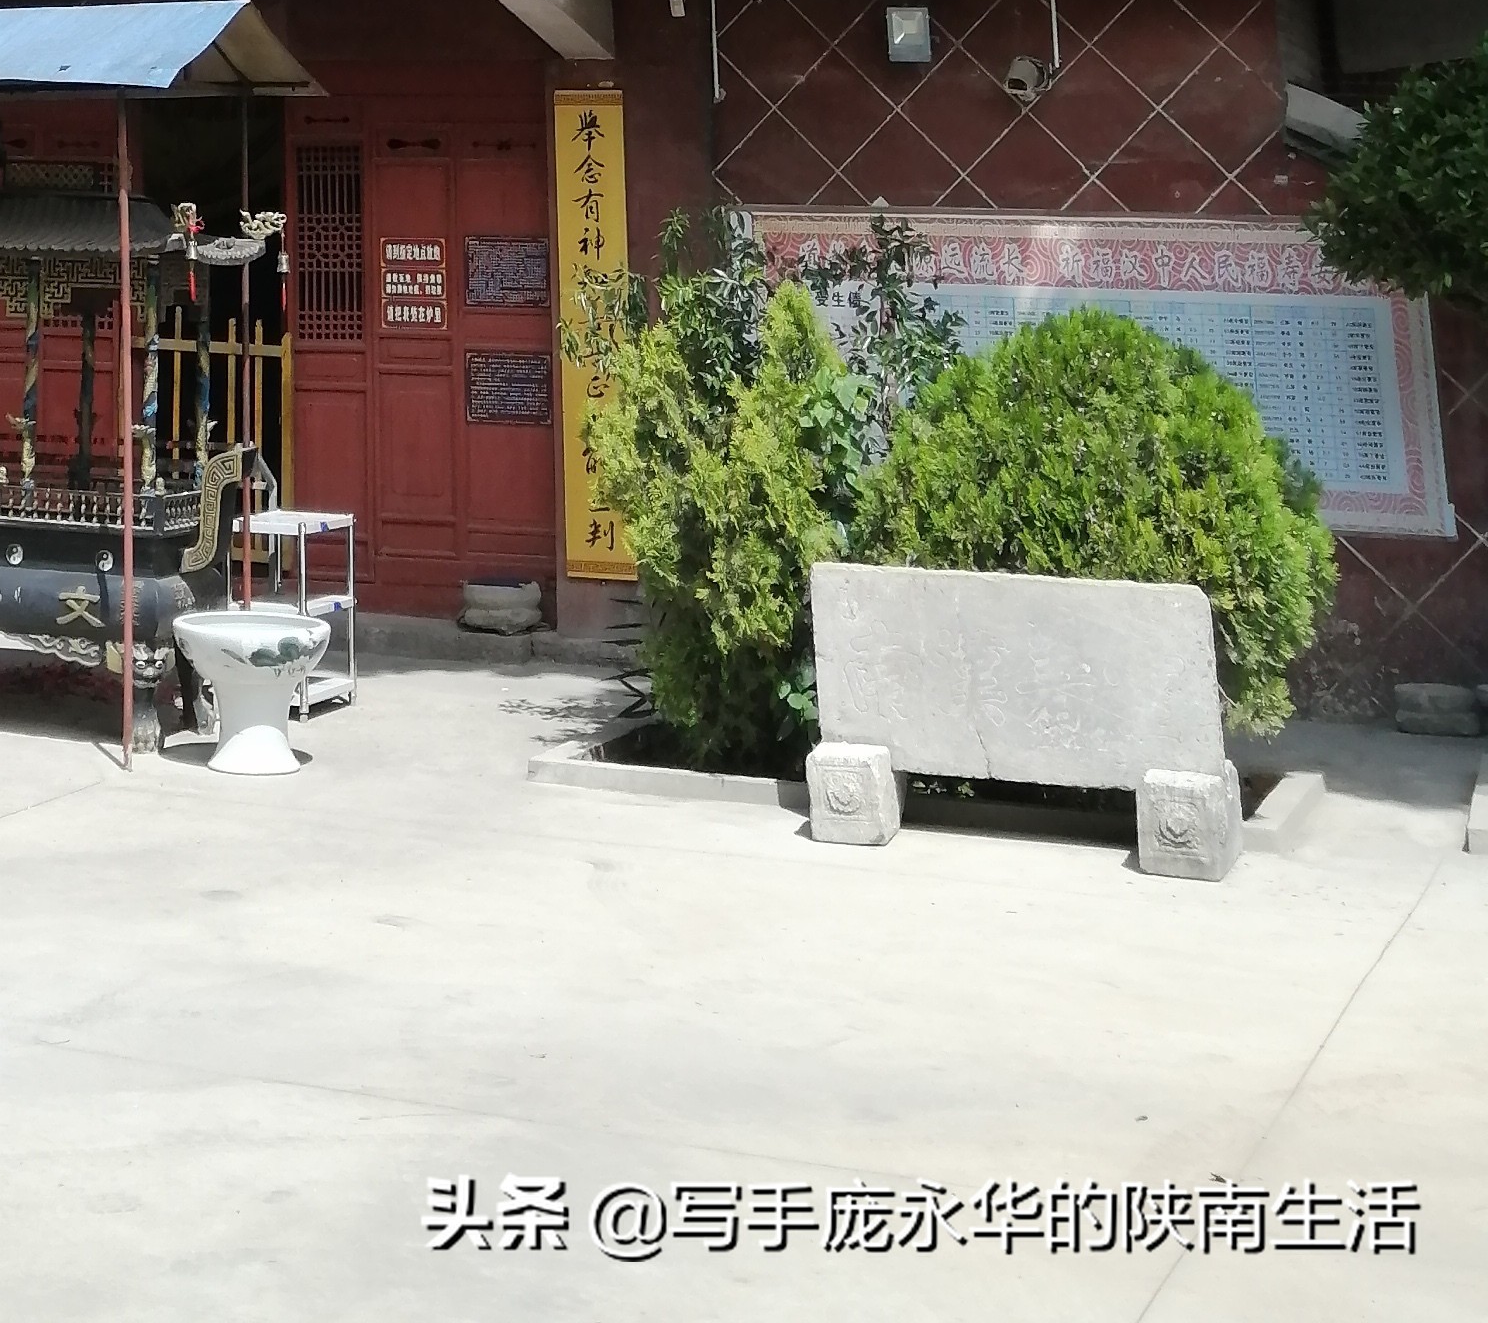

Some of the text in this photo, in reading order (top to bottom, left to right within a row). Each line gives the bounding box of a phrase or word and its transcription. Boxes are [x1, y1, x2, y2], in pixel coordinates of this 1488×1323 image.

[1060, 243, 1370, 289] 祈福汉中人民福寿安
